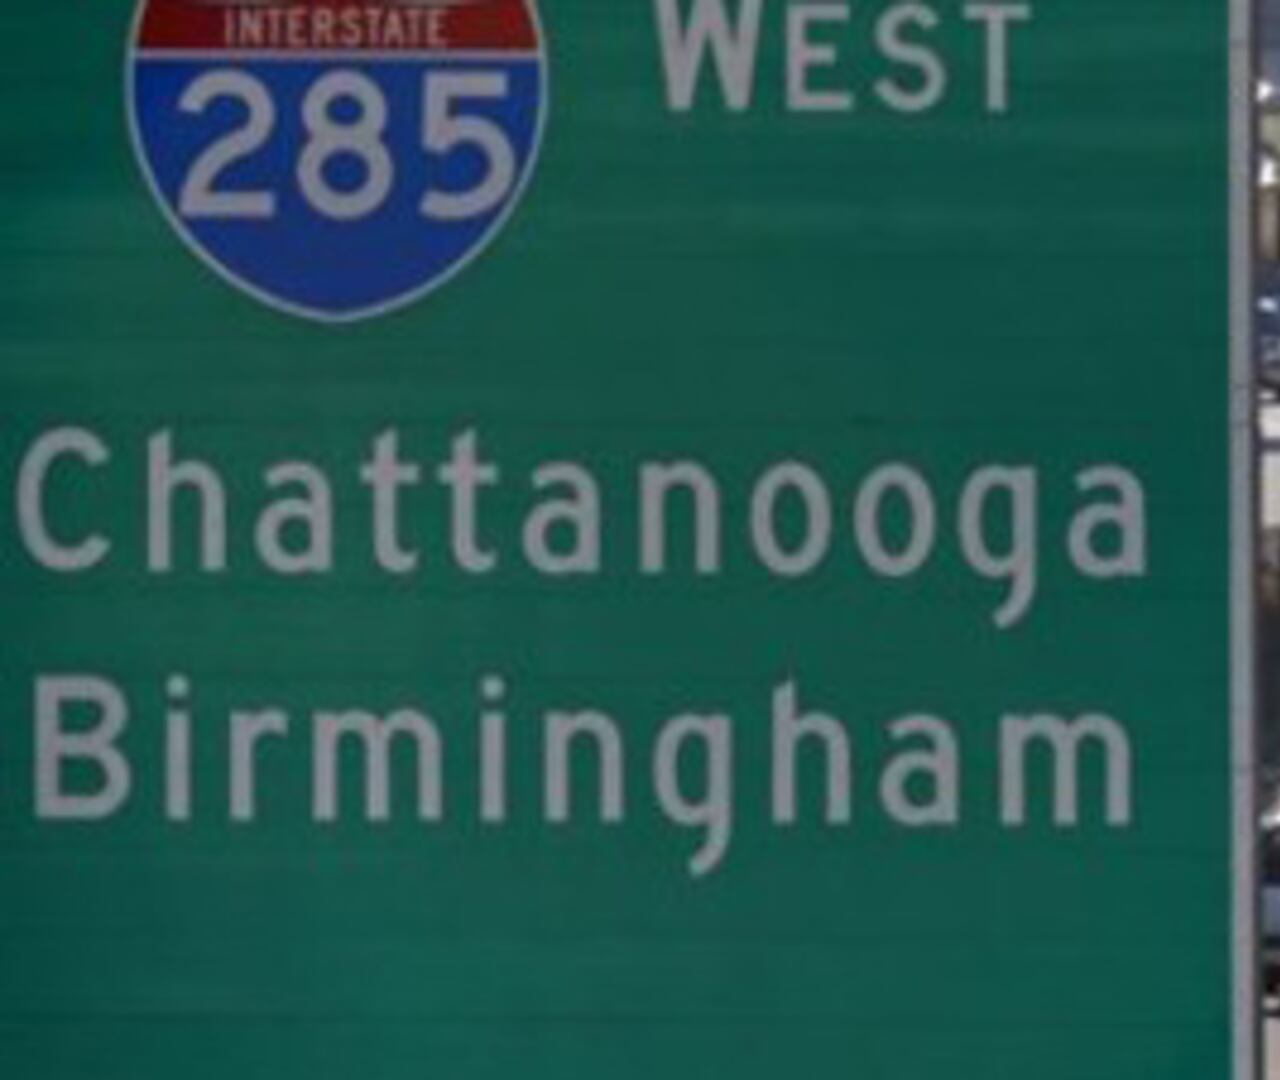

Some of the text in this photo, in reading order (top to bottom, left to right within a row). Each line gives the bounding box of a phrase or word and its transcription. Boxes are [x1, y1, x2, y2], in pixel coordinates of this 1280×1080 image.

[224, 7, 448, 48] INTERSTATE
[655, 0, 1031, 111] WEST
[178, 70, 516, 220] 285
[16, 427, 1147, 629] Chattanooga
[33, 676, 1133, 876] Birmingham
